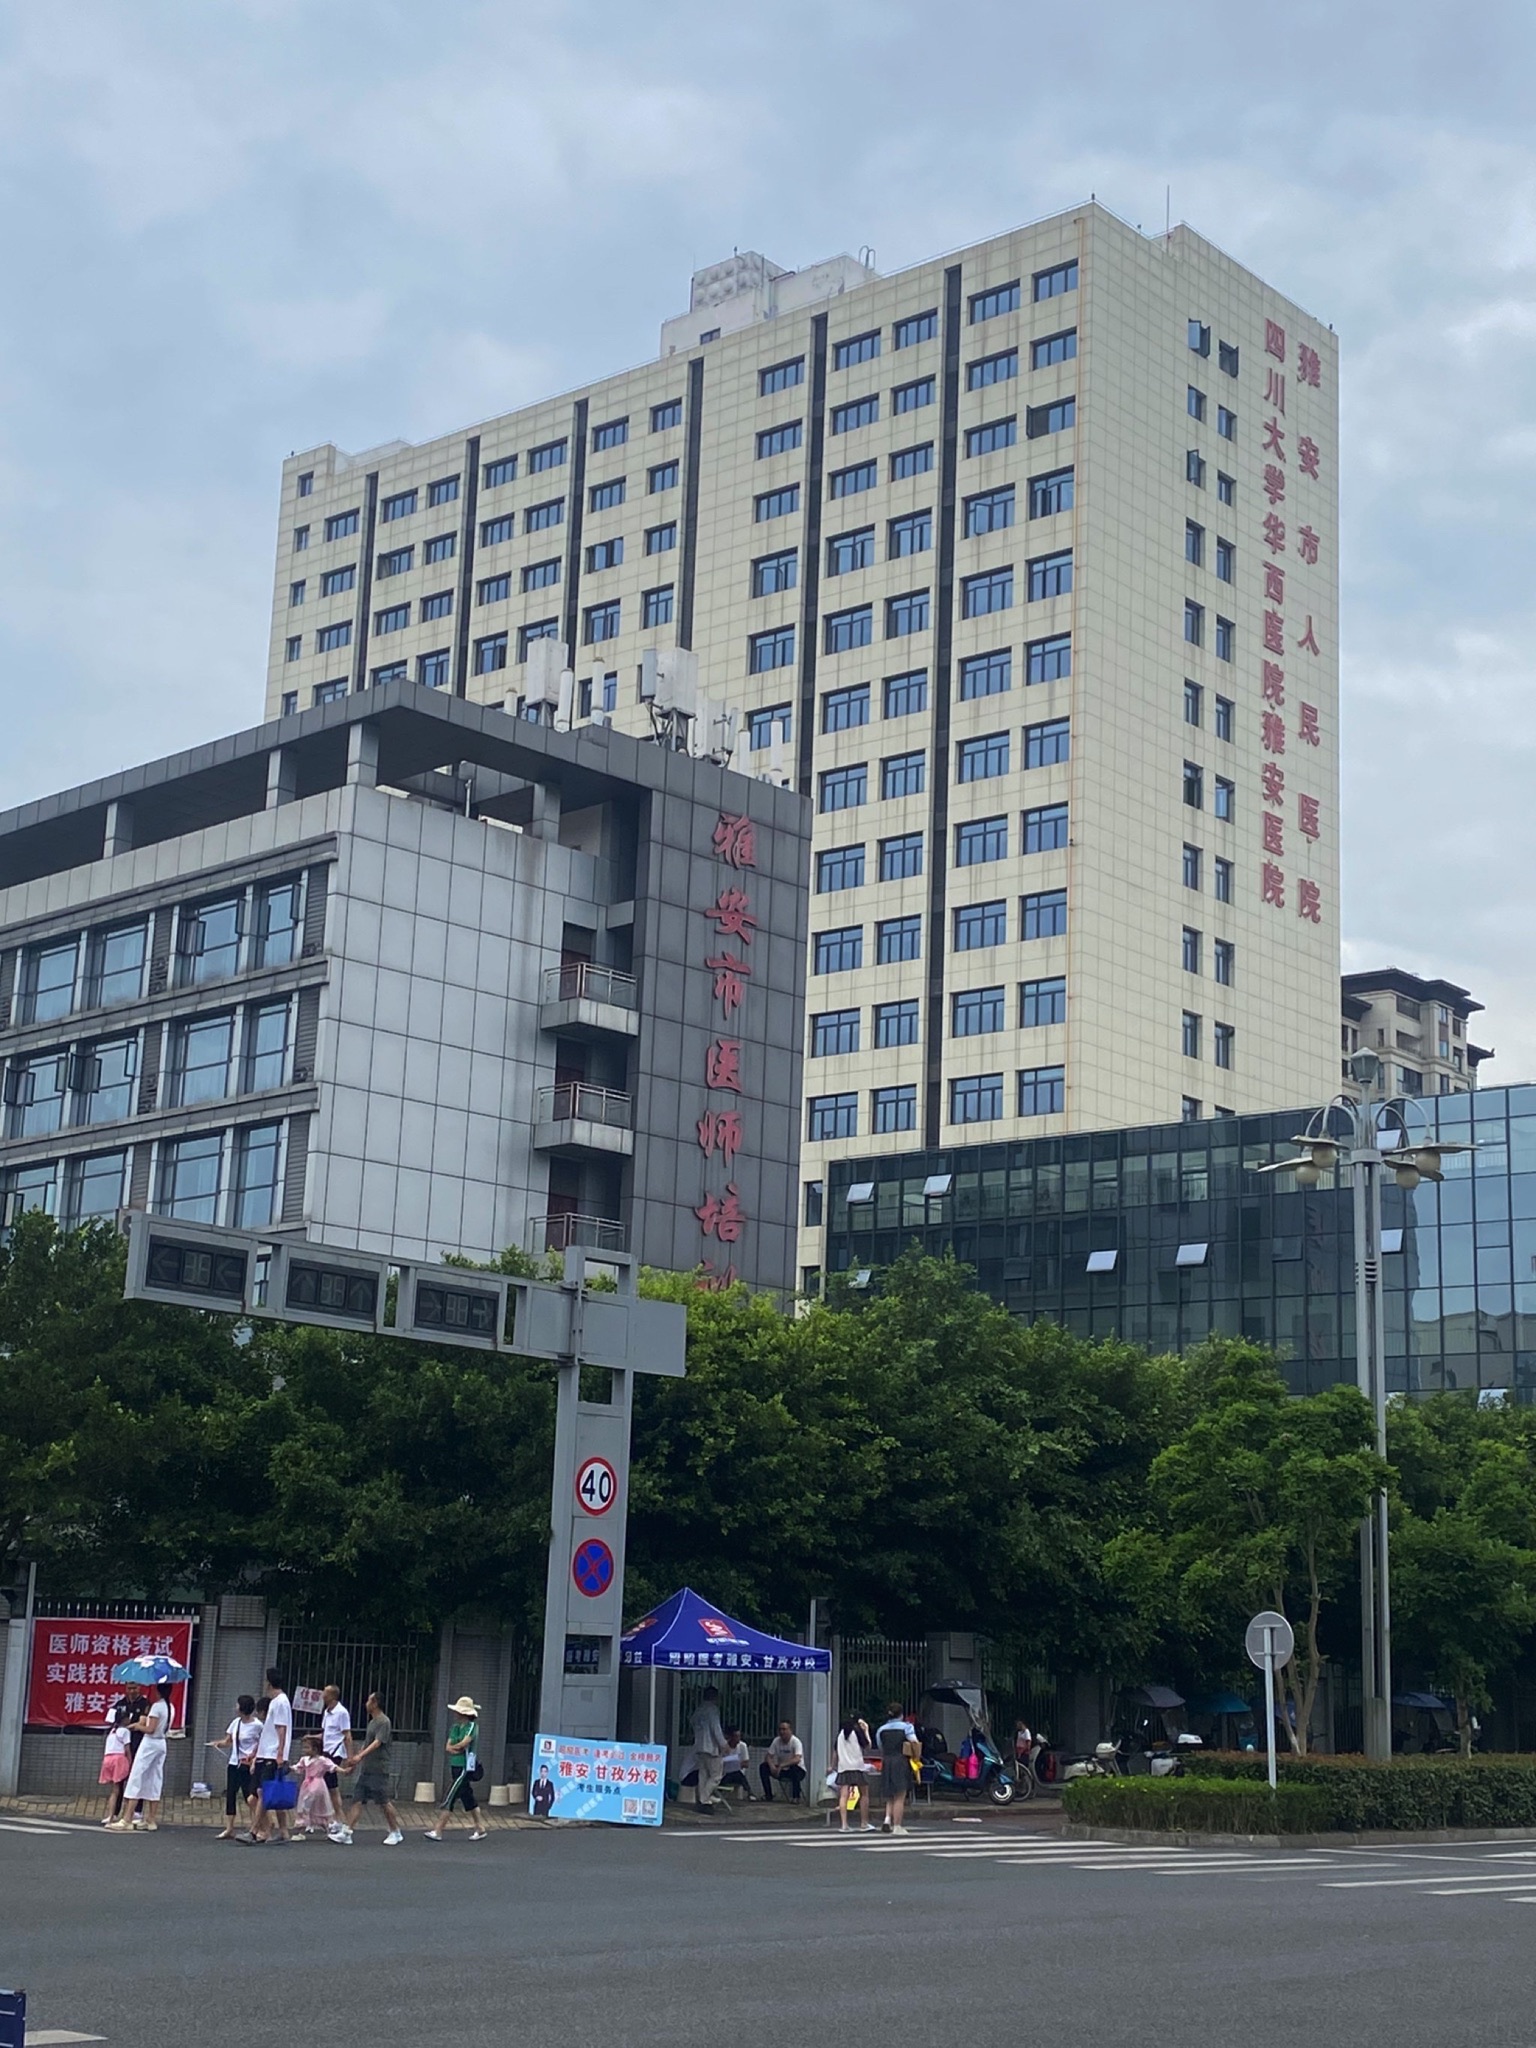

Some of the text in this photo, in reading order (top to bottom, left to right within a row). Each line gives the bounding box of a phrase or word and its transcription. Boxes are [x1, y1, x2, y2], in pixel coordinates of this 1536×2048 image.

[1262, 318, 1286, 910] 四川大学华西医院雅安医院
[1297, 341, 1321, 924] 雅安市人民医院
[582, 1469, 612, 1503] 40
[48, 1633, 174, 1656] 医师资格考试
[559, 1762, 658, 1785] 雅安 甘孜分校
